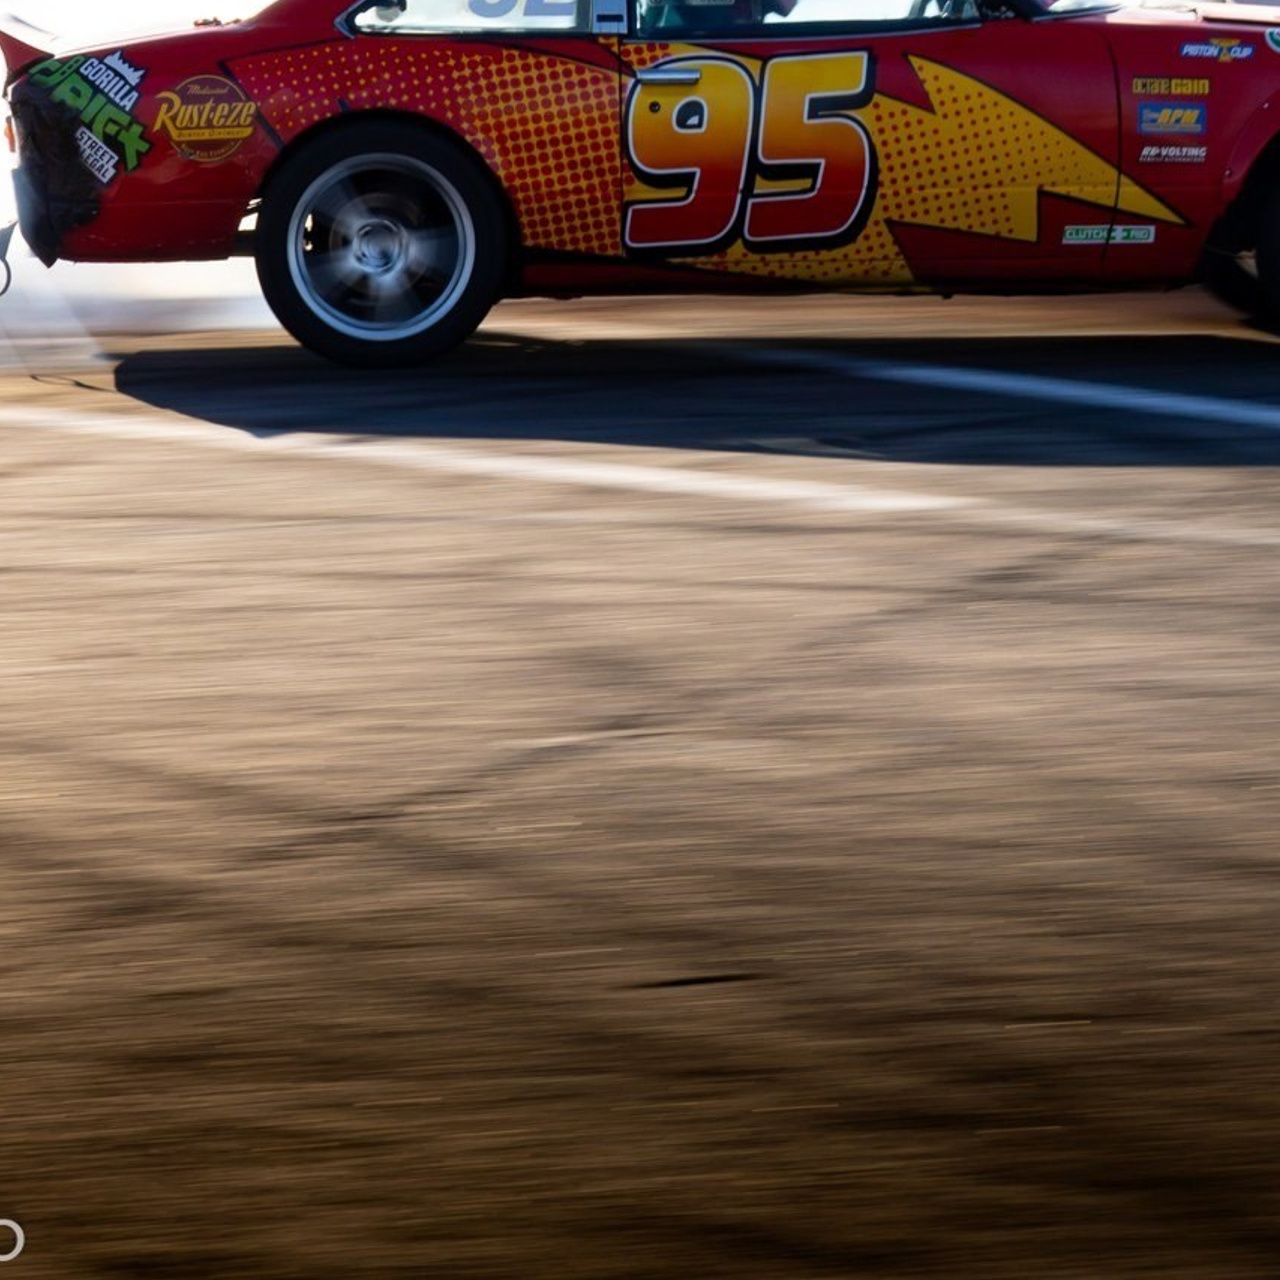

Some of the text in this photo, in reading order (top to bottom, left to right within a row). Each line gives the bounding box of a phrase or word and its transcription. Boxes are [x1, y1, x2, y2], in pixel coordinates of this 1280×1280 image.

[1182, 43, 1254, 58] PISTON CUP
[79, 57, 139, 113] GORILLA
[79, 130, 117, 167] STREET
[81, 147, 113, 179] LEGAL
[624, 51, 872, 248] 95
